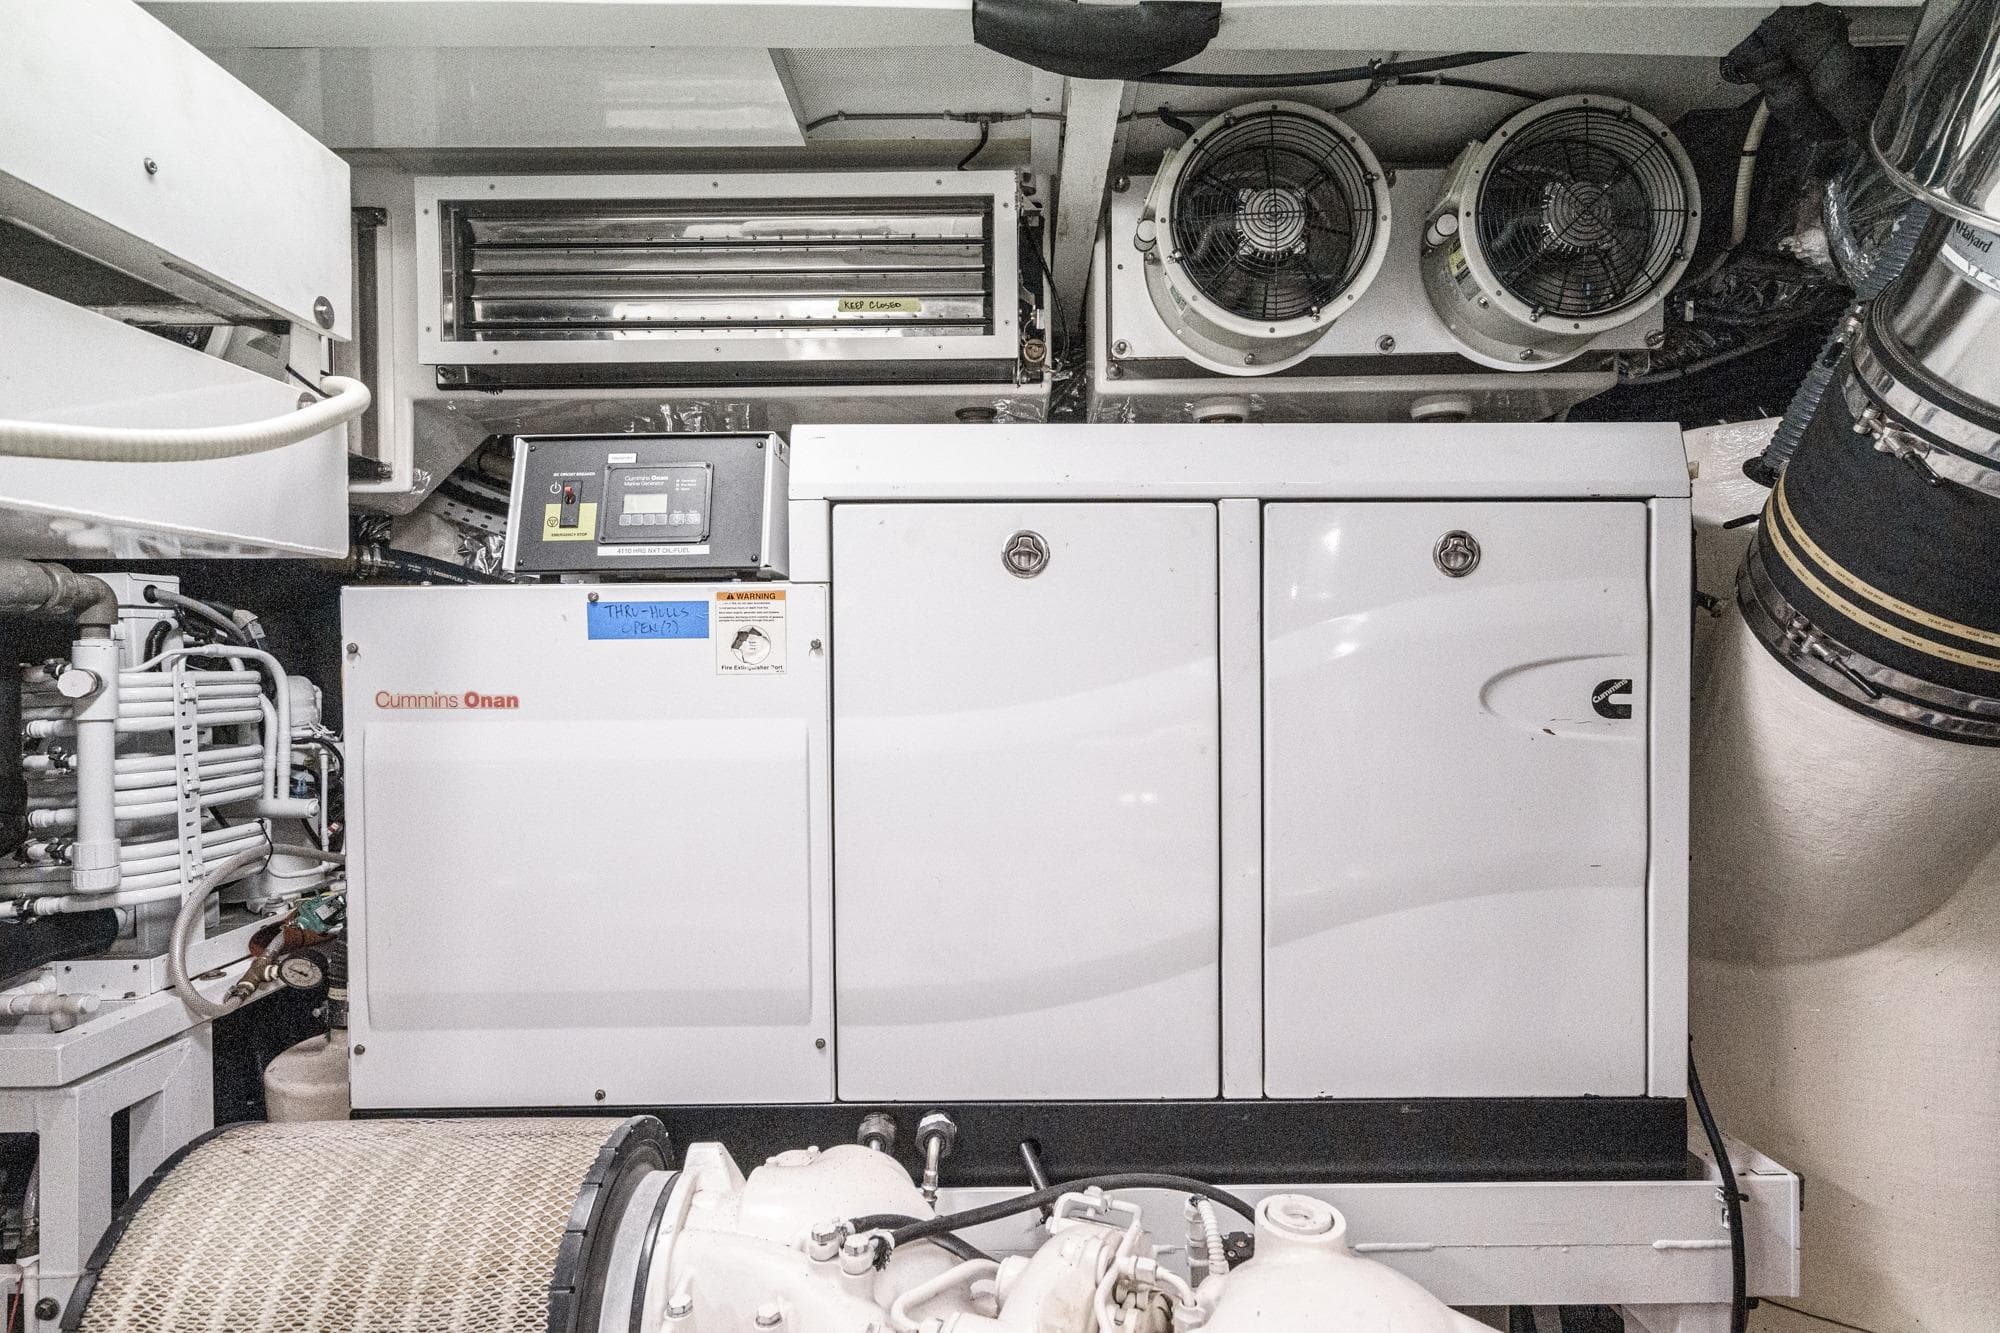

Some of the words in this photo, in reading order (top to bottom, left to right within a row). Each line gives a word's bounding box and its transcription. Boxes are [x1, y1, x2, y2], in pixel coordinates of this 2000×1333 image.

[1959, 222, 1993, 253] Halyard
[844, 300, 864, 310] KEEP
[737, 592, 776, 600] WARNING
[375, 690, 458, 709] Cummins
[464, 691, 520, 708] Onan
[1592, 679, 1629, 704] Cummins
